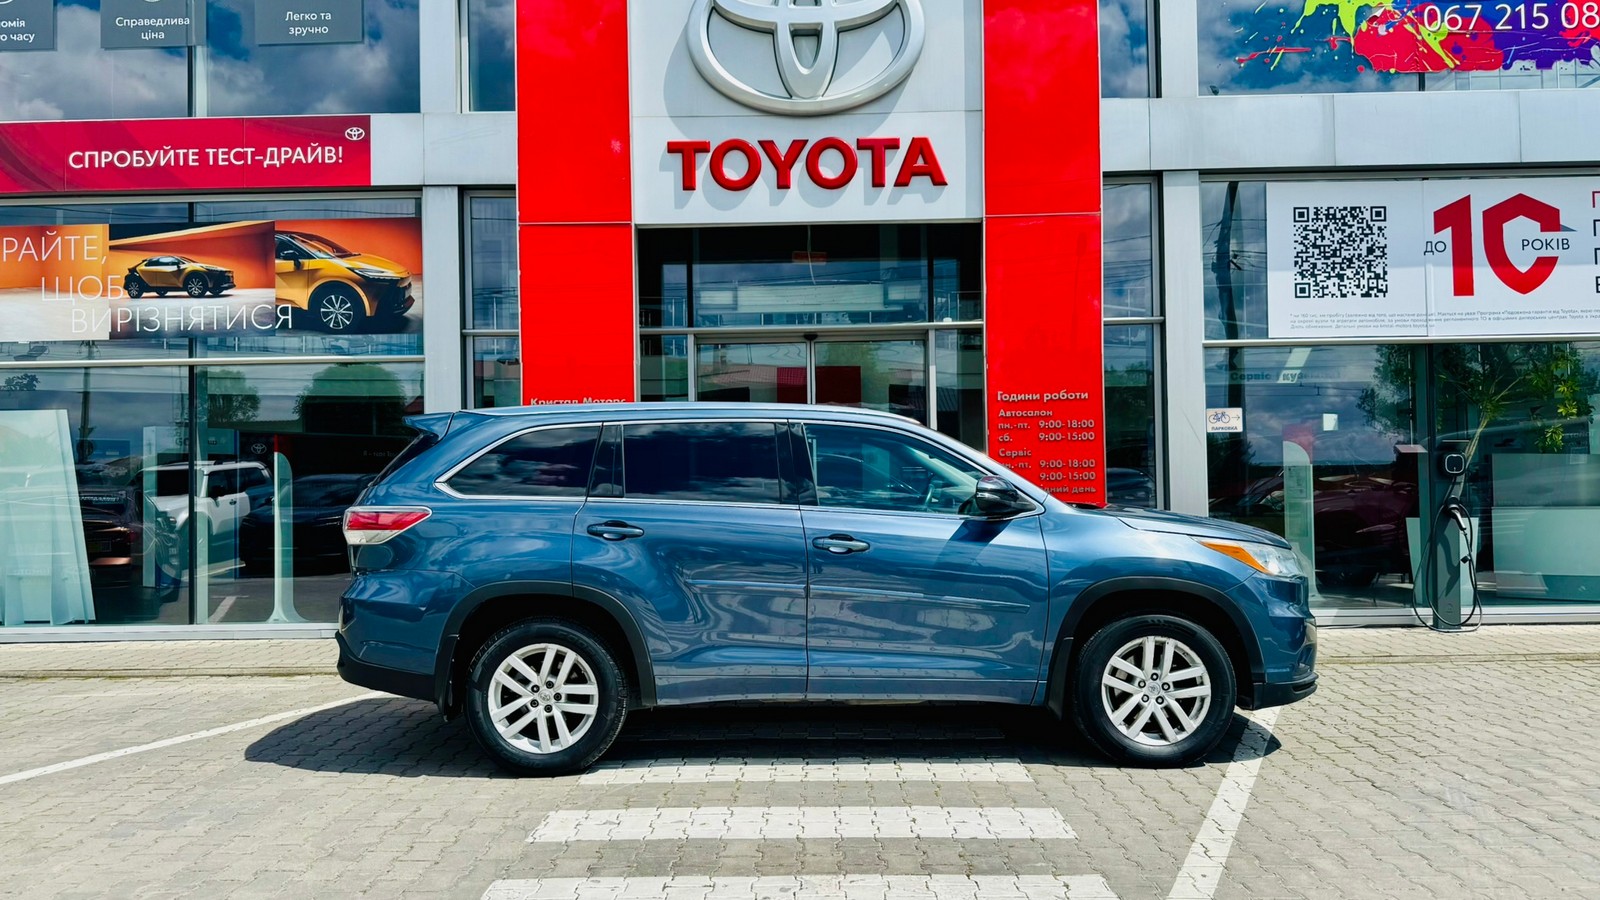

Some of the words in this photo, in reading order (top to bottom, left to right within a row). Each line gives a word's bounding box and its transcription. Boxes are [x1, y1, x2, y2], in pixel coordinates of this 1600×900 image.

[115, 16, 190, 28] Справедлива
[285, 11, 316, 22] Легко
[319, 12, 332, 21] та
[1423, 4, 1482, 31] 067
[1495, 3, 1549, 30] 215
[1560, 2, 1600, 29] 08
[141, 29, 165, 41] ціна
[288, 24, 329, 36] зручно
[10, 33, 35, 43] часу
[68, 145, 199, 169] СПРОБУЙТЕ
[205, 142, 344, 168] ТЕСТ-ДРАЙВ!
[667, 136, 948, 192] TOYOTA
[2, 231, 108, 264] РАЙТЕ,
[1423, 240, 1447, 256] ДО
[1521, 237, 1571, 252] РОКІВ
[41, 274, 123, 307] ЩОБ
[71, 303, 293, 334] ВИРІЗНЯТИСЯ
[997, 390, 1040, 402] Години
[1043, 389, 1089, 403] роботи
[998, 408, 1053, 418] Автосалон
[1038, 420, 1095, 428] 9:00-18:00
[998, 433, 1013, 442] сб.
[1038, 432, 1095, 441] 9:00-15:00
[999, 447, 1032, 458] Сервіс
[1071, 486, 1097, 494] день
